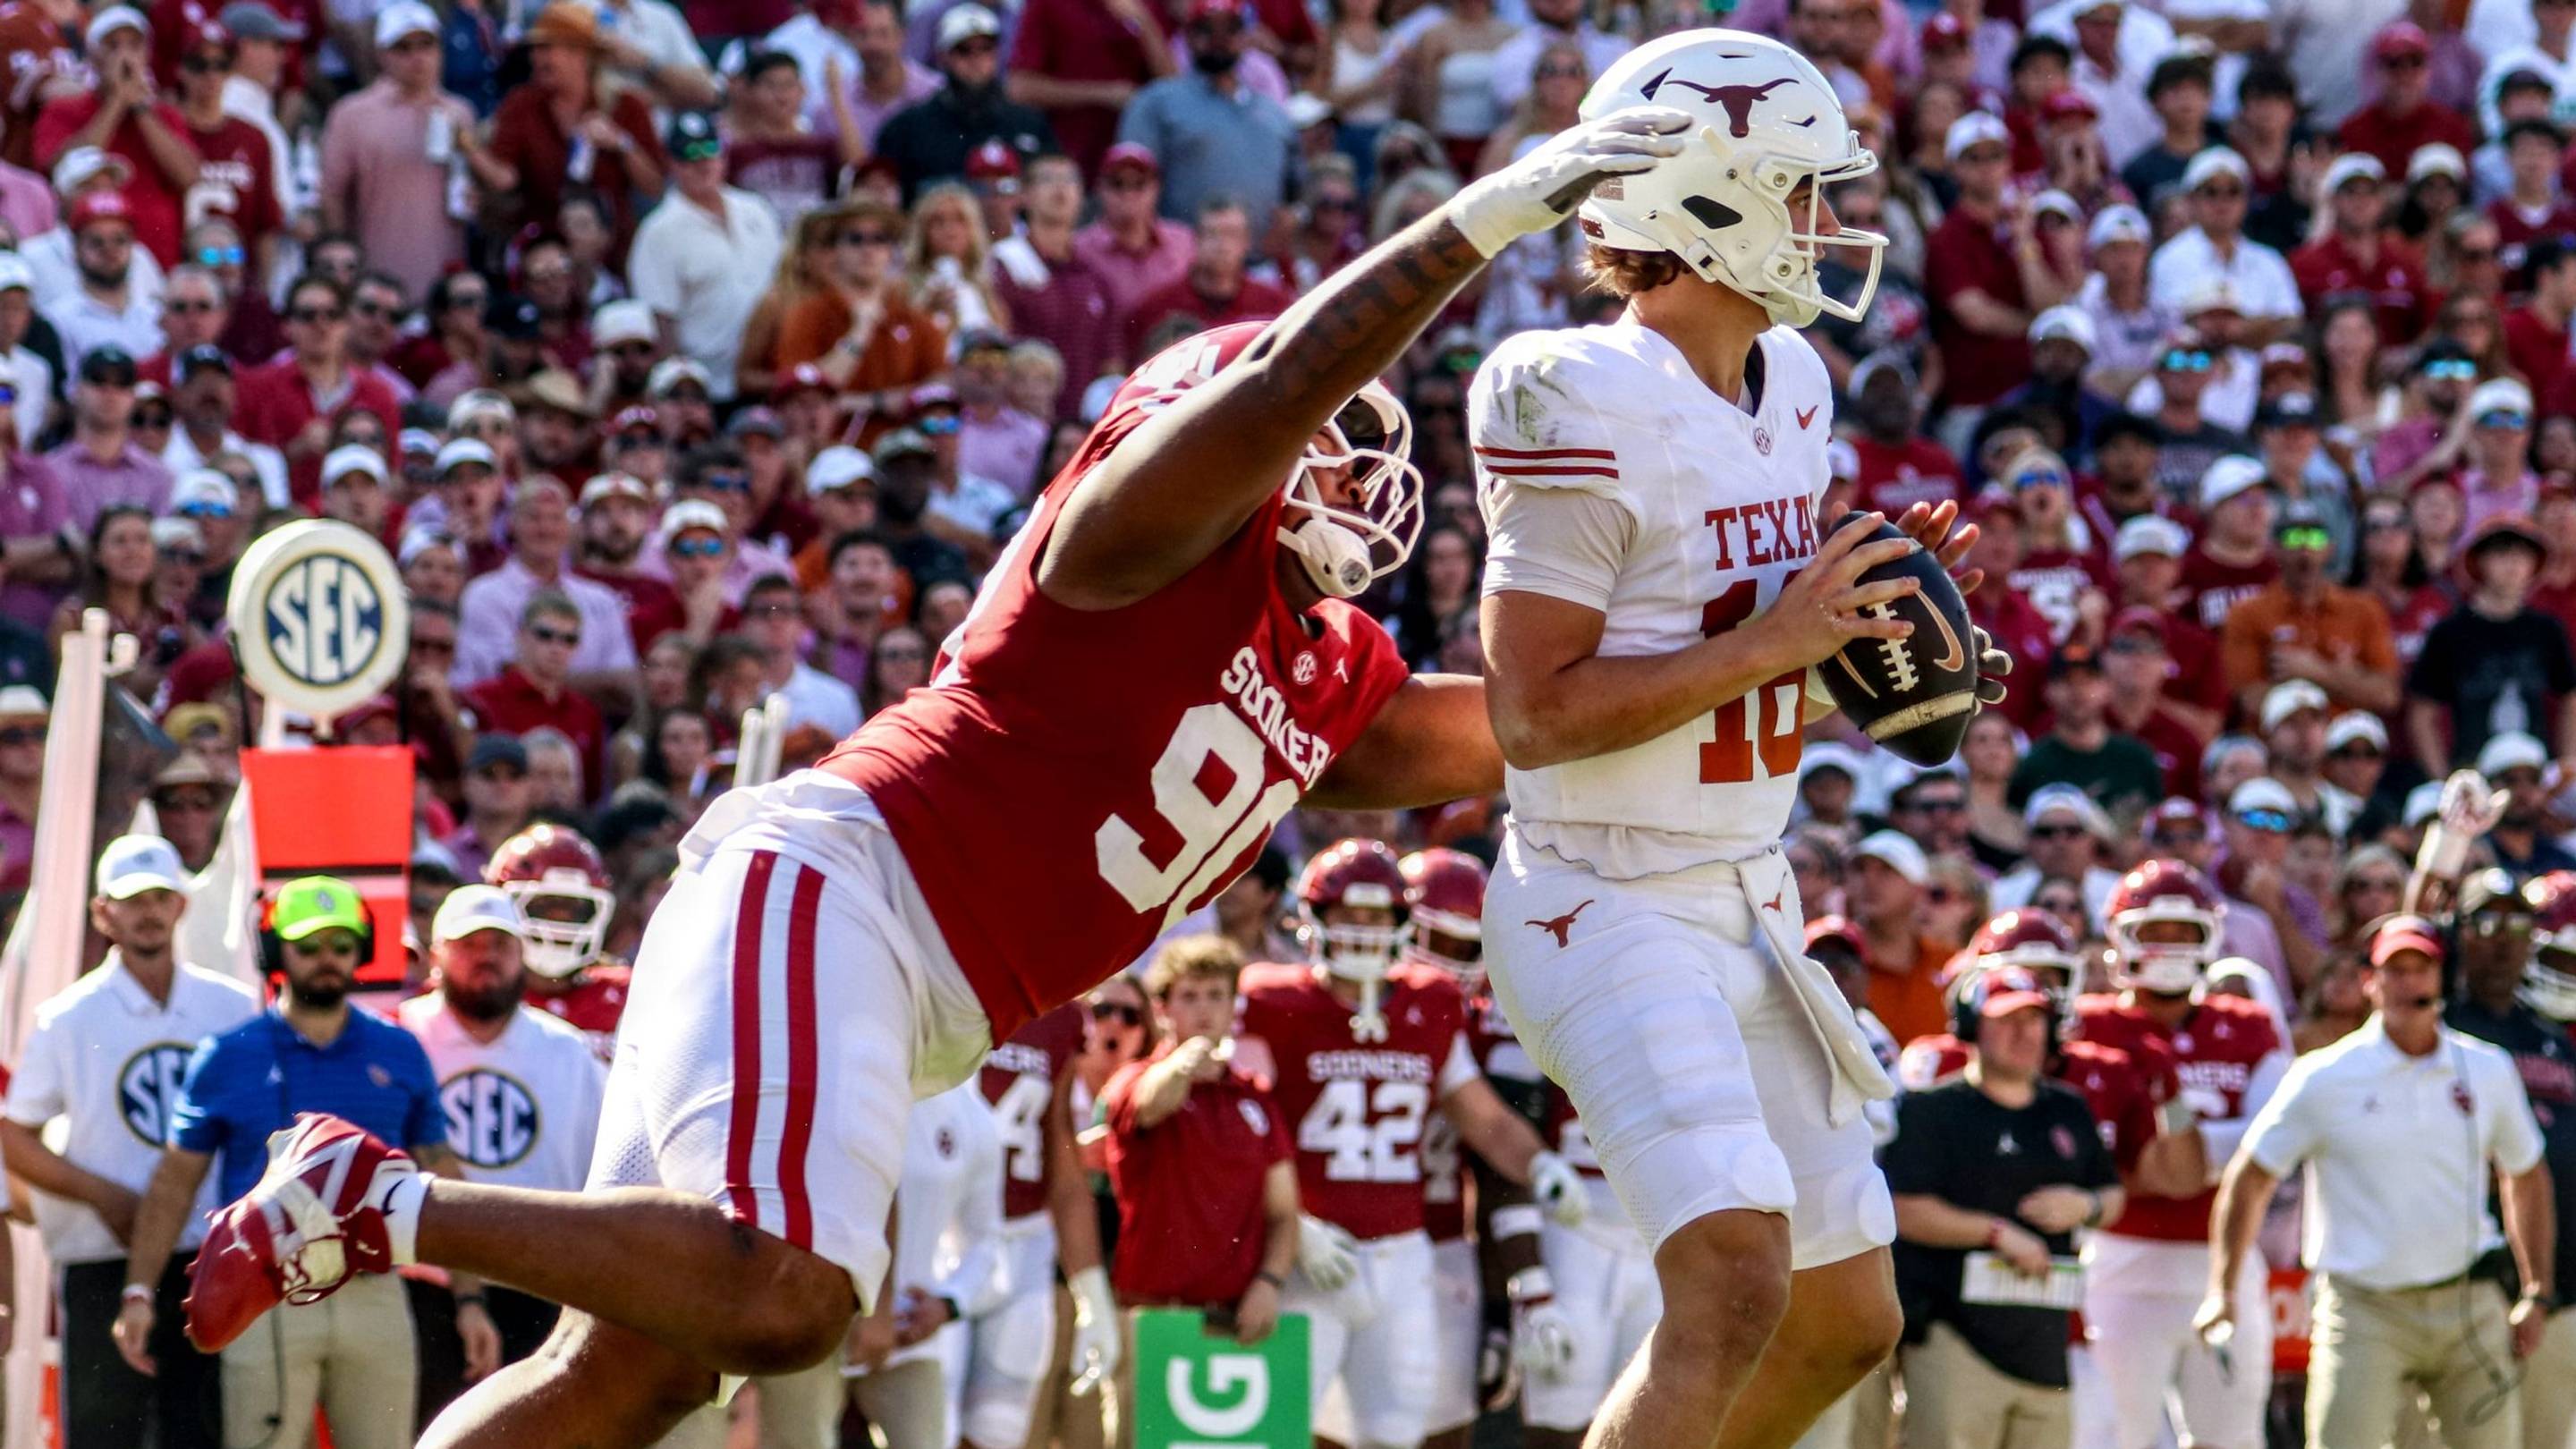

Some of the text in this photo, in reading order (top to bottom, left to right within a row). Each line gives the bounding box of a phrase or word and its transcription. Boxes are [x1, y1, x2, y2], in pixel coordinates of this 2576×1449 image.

[1705, 491, 1821, 571] TEXA
[269, 557, 377, 681] SEC
[1220, 646, 1336, 792] SOONER
[124, 1049, 192, 1143] SE
[1307, 1049, 1433, 1083] SOONERS
[440, 1072, 531, 1164] SEC
[1298, 1080, 1429, 1182] 42
[1165, 1352, 1271, 1449] G
